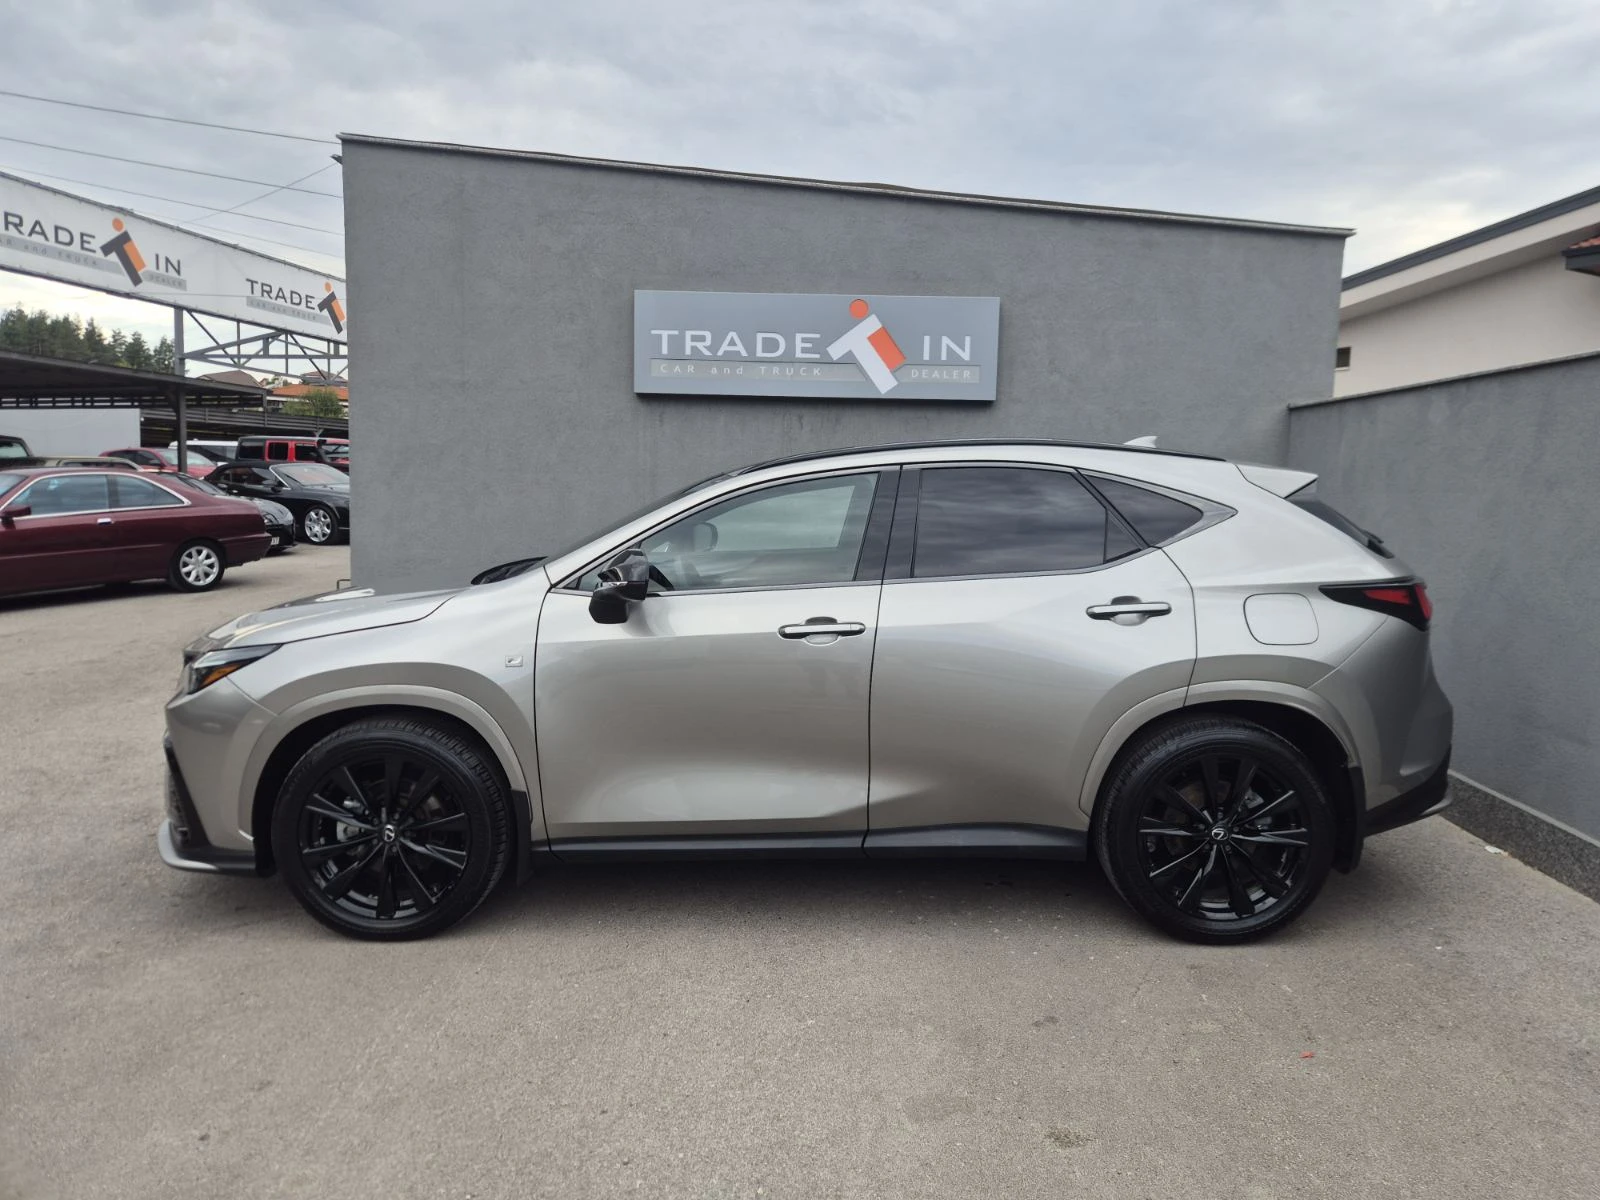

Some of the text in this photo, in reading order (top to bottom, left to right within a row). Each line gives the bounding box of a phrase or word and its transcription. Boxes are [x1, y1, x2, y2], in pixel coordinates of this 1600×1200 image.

[3, 210, 97, 254] RADE
[155, 253, 181, 276] IN
[245, 278, 316, 311] TRADE
[650, 329, 822, 360] TRADE
[922, 335, 972, 361] IN
[659, 363, 972, 379] CAR and TRUCK DEALER
